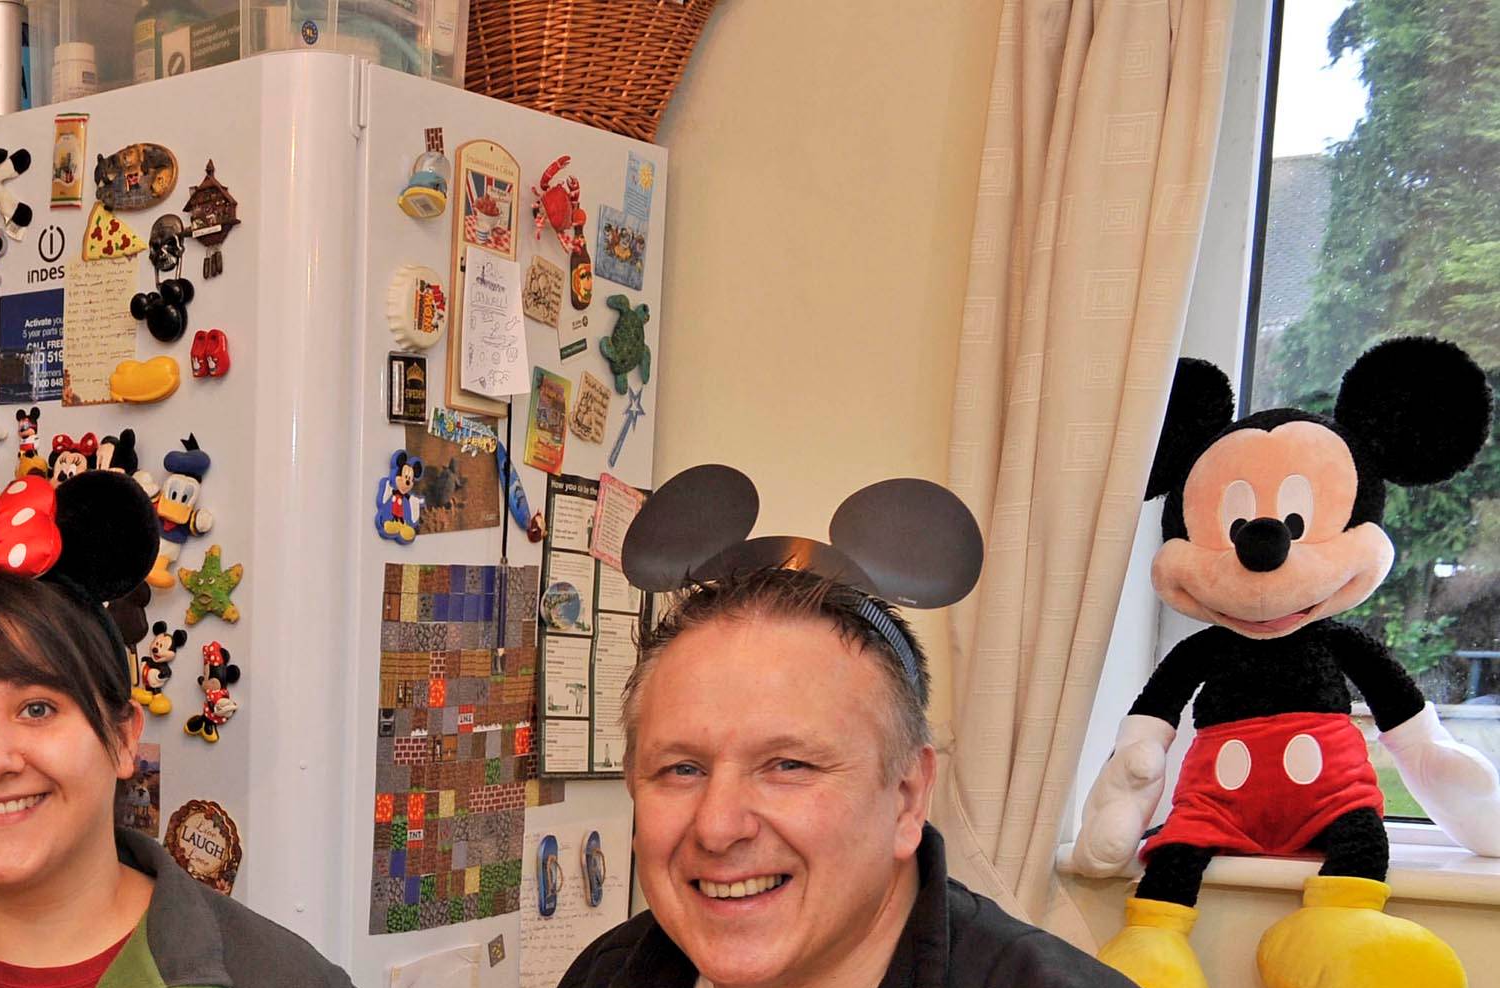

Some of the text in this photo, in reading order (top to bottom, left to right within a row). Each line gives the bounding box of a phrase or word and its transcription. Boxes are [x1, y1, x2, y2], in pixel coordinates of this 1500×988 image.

[24, 317, 52, 328] Activate
[26, 341, 46, 351] CALL
[565, 483, 577, 492] you
[460, 713, 472, 722] TNT
[409, 830, 422, 839] TNT
[181, 825, 224, 859] LAUGH
